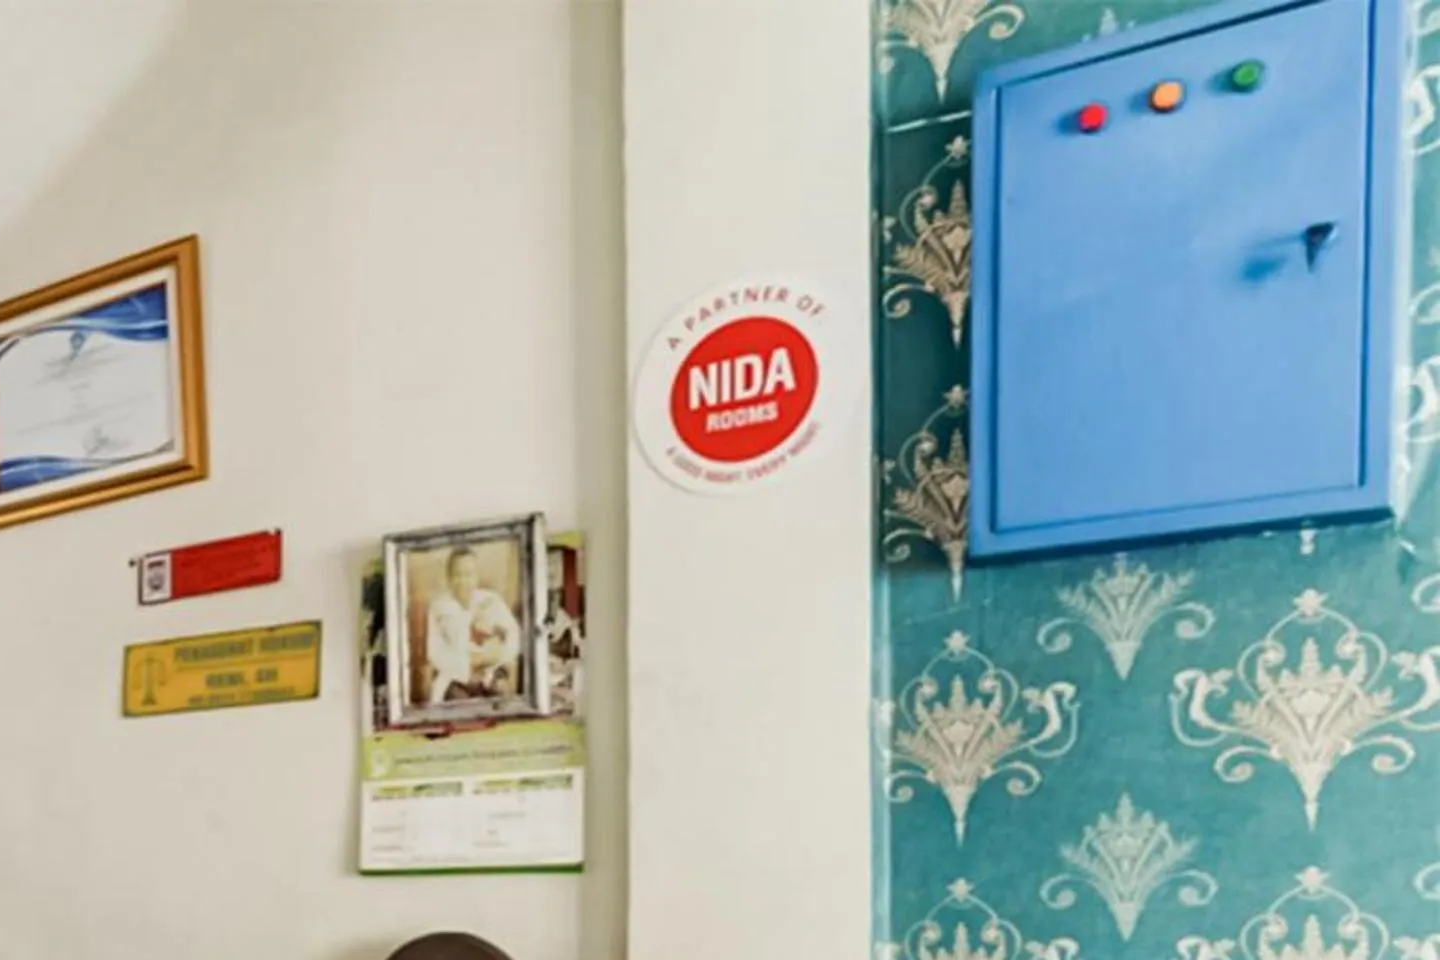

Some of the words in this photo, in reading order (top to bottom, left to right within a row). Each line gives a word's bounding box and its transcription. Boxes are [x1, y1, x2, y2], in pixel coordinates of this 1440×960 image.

[684, 285, 790, 330] PARTNER
[796, 295, 825, 317] OF
[689, 347, 796, 409] NIDA
[706, 402, 778, 432] ROOMS
